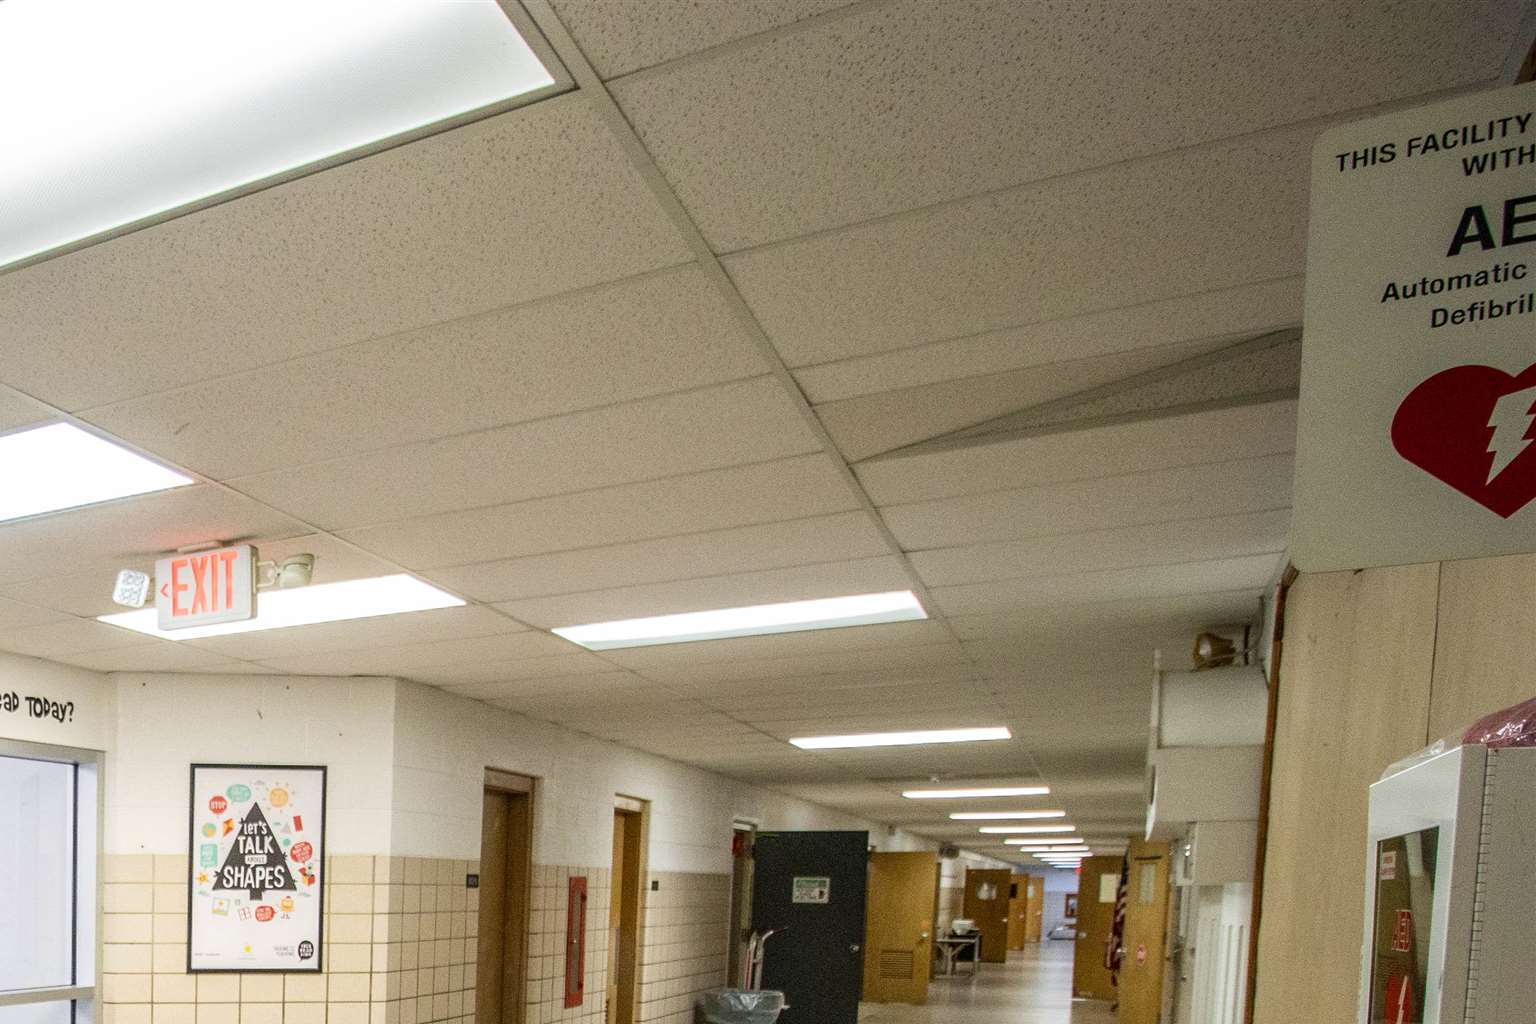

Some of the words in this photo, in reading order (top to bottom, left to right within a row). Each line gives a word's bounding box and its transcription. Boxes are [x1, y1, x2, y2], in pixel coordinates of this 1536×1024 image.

[1336, 143, 1396, 172] THIS
[1407, 113, 1532, 158] FACILITY
[1462, 144, 1536, 176] WITH
[1446, 194, 1536, 257] AE
[1380, 262, 1529, 304] Automatic
[171, 551, 238, 617] EXIT
[237, 835, 274, 854] TALK
[222, 865, 285, 889] SHAPES
